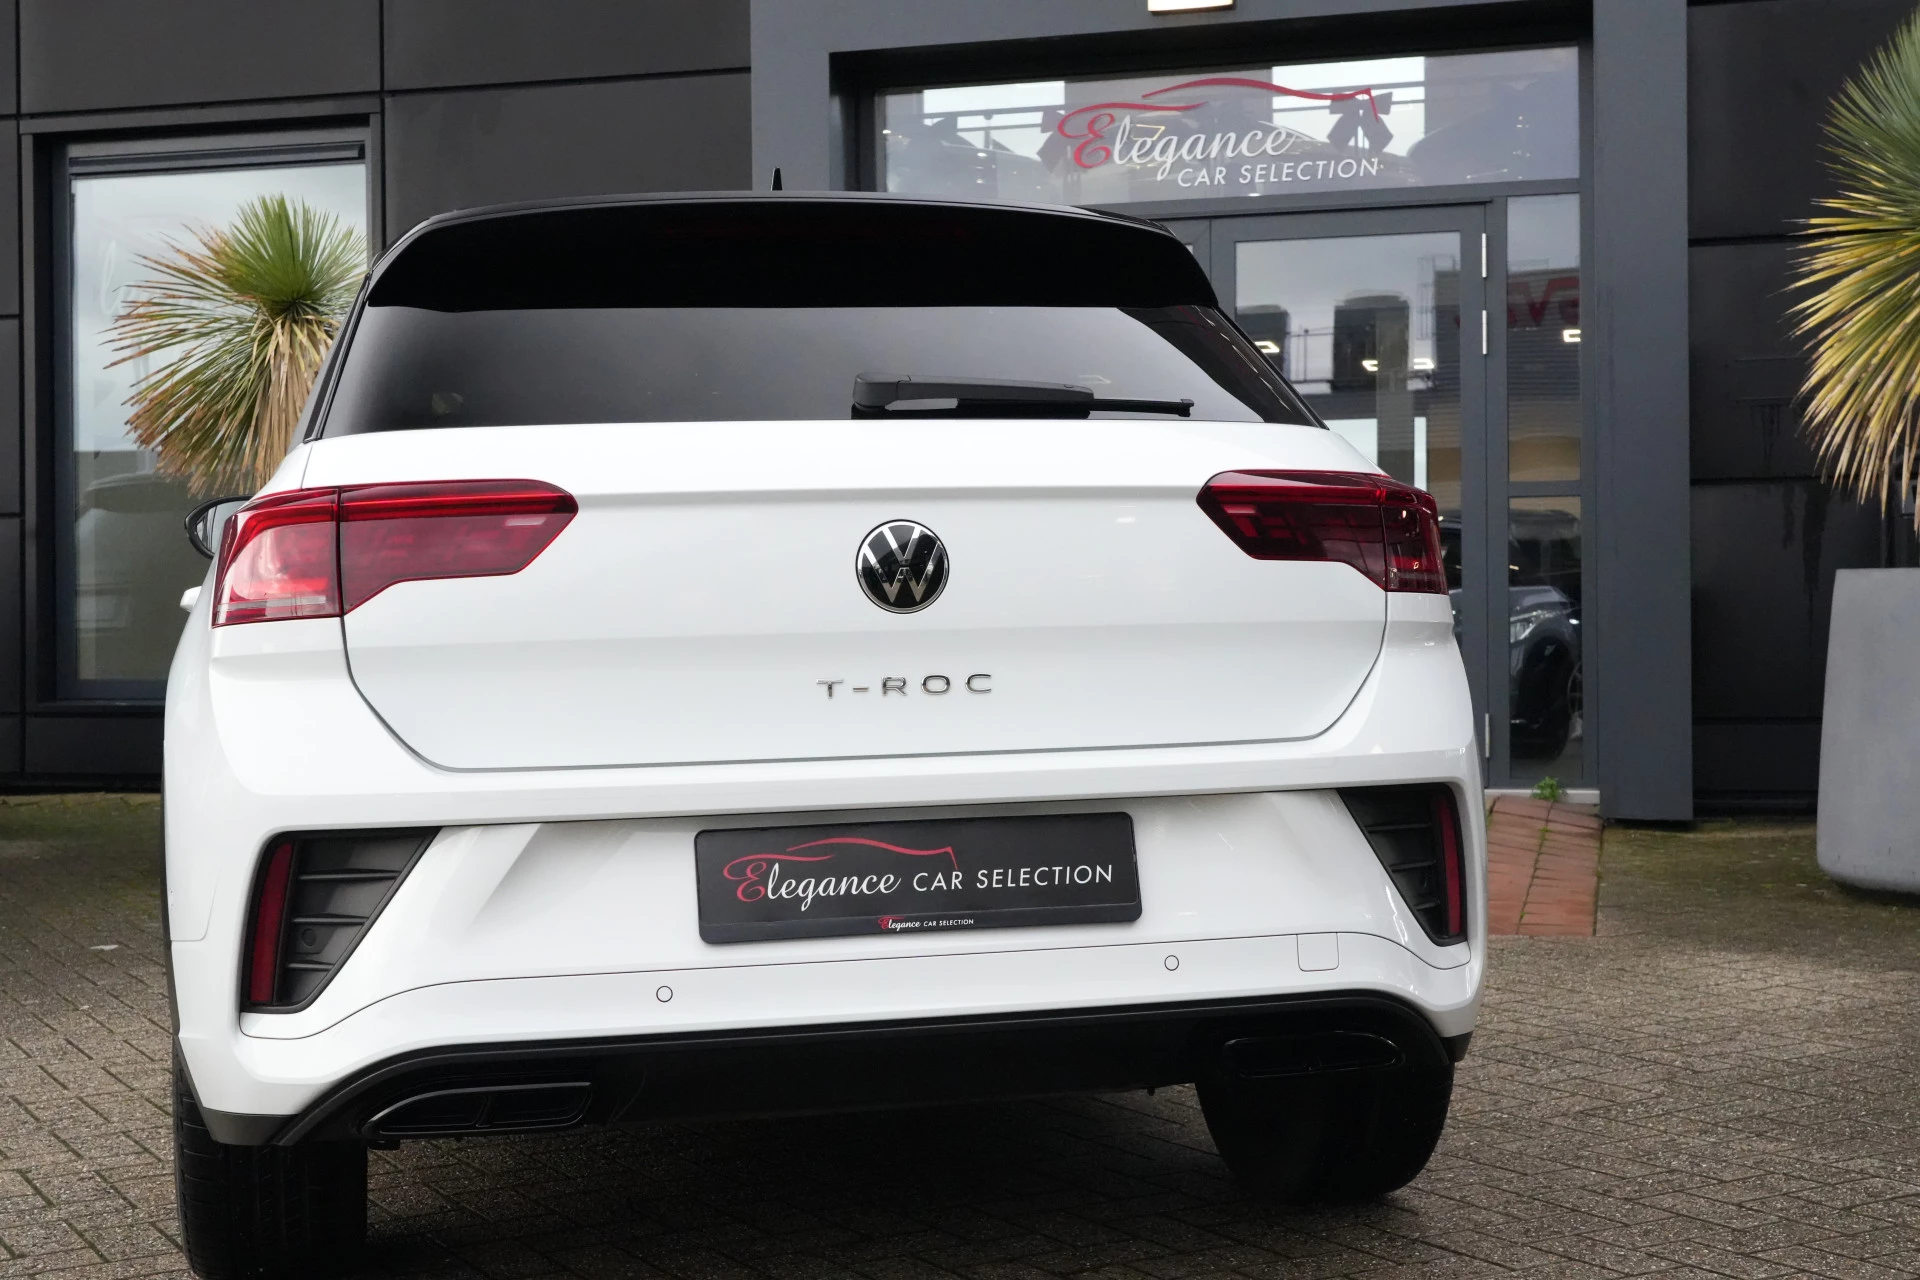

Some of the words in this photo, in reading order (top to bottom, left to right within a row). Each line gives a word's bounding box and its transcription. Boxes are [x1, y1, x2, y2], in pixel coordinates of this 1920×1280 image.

[1057, 104, 1296, 181] Elegance
[1178, 168, 1227, 188] CAR
[1240, 157, 1378, 184] SELECTION
[816, 673, 993, 699] T-ROC
[723, 854, 901, 911] Elegance
[912, 870, 963, 892] CAR
[976, 864, 1113, 889] SELECTION
[878, 915, 921, 931] Elegance
[938, 918, 974, 926] SELECTION
